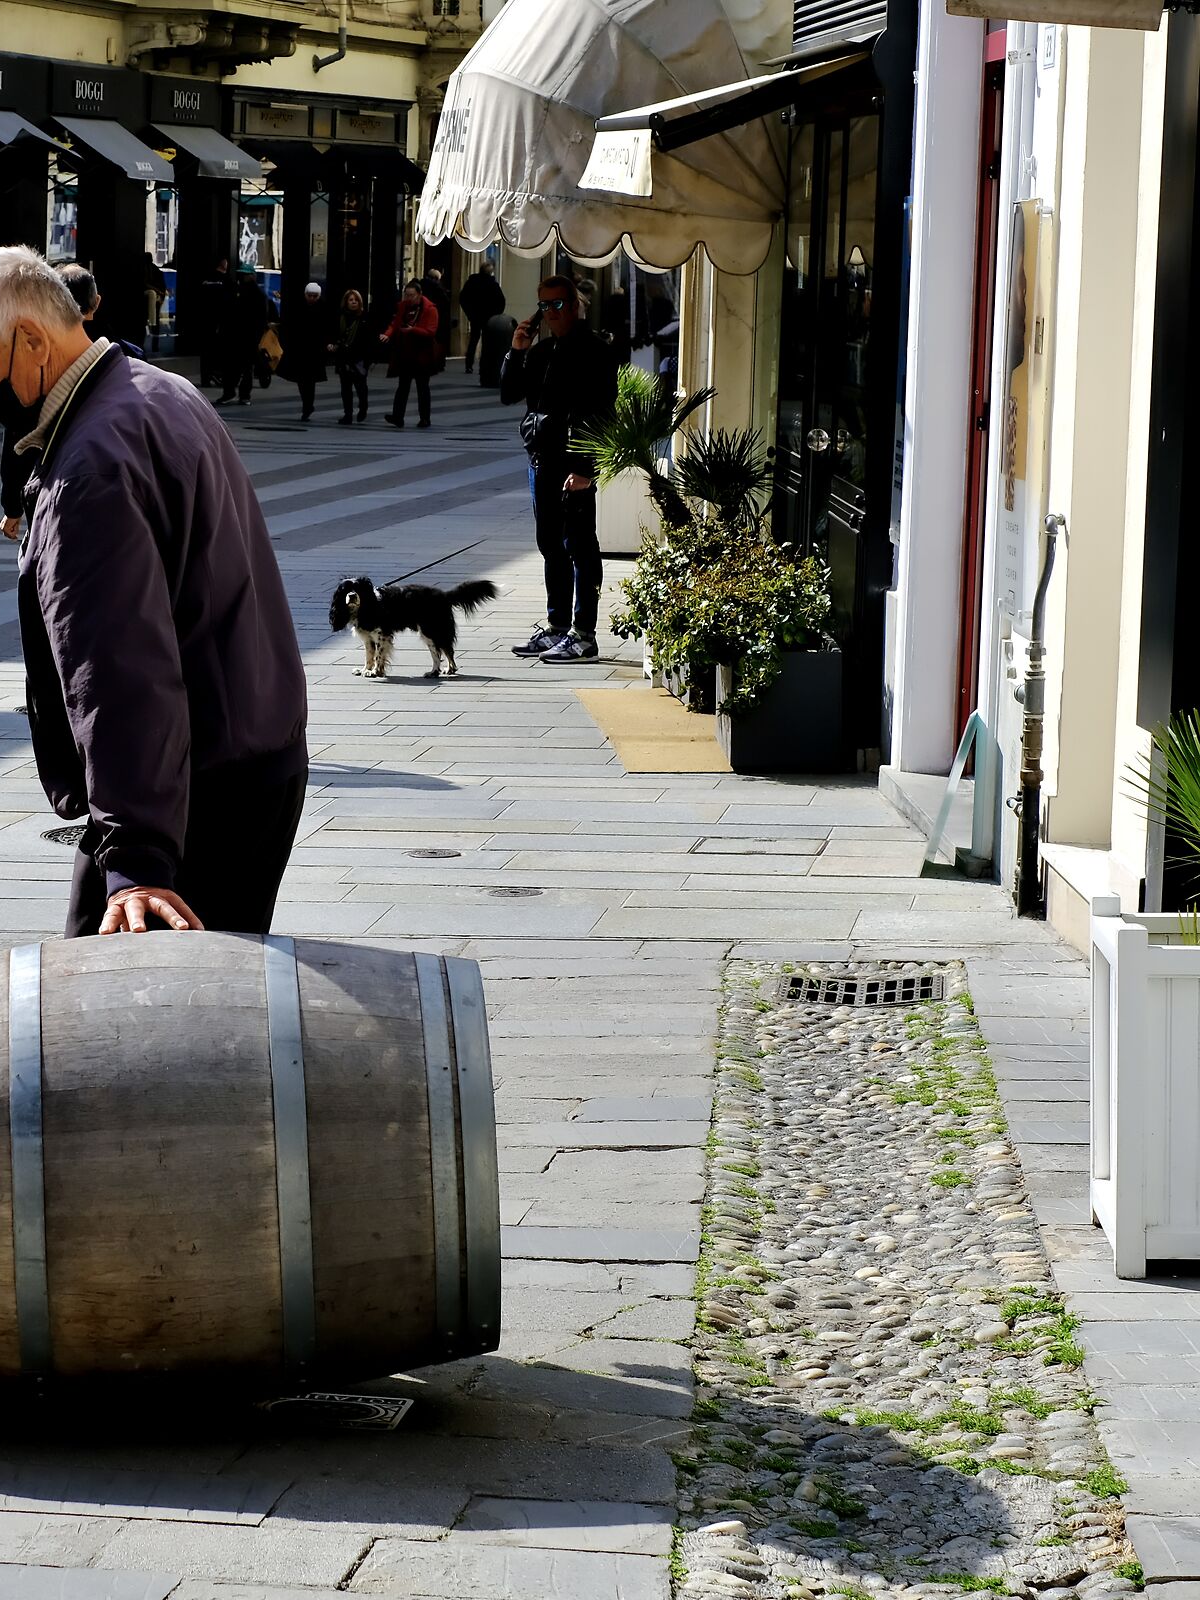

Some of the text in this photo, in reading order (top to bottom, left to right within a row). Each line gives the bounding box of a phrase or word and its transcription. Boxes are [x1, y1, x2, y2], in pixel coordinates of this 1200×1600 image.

[75, 79, 104, 100] BOGGI
[173, 90, 200, 110] BOGGI
[77, 104, 101, 112] MILANO
[175, 113, 198, 121] MILANO
